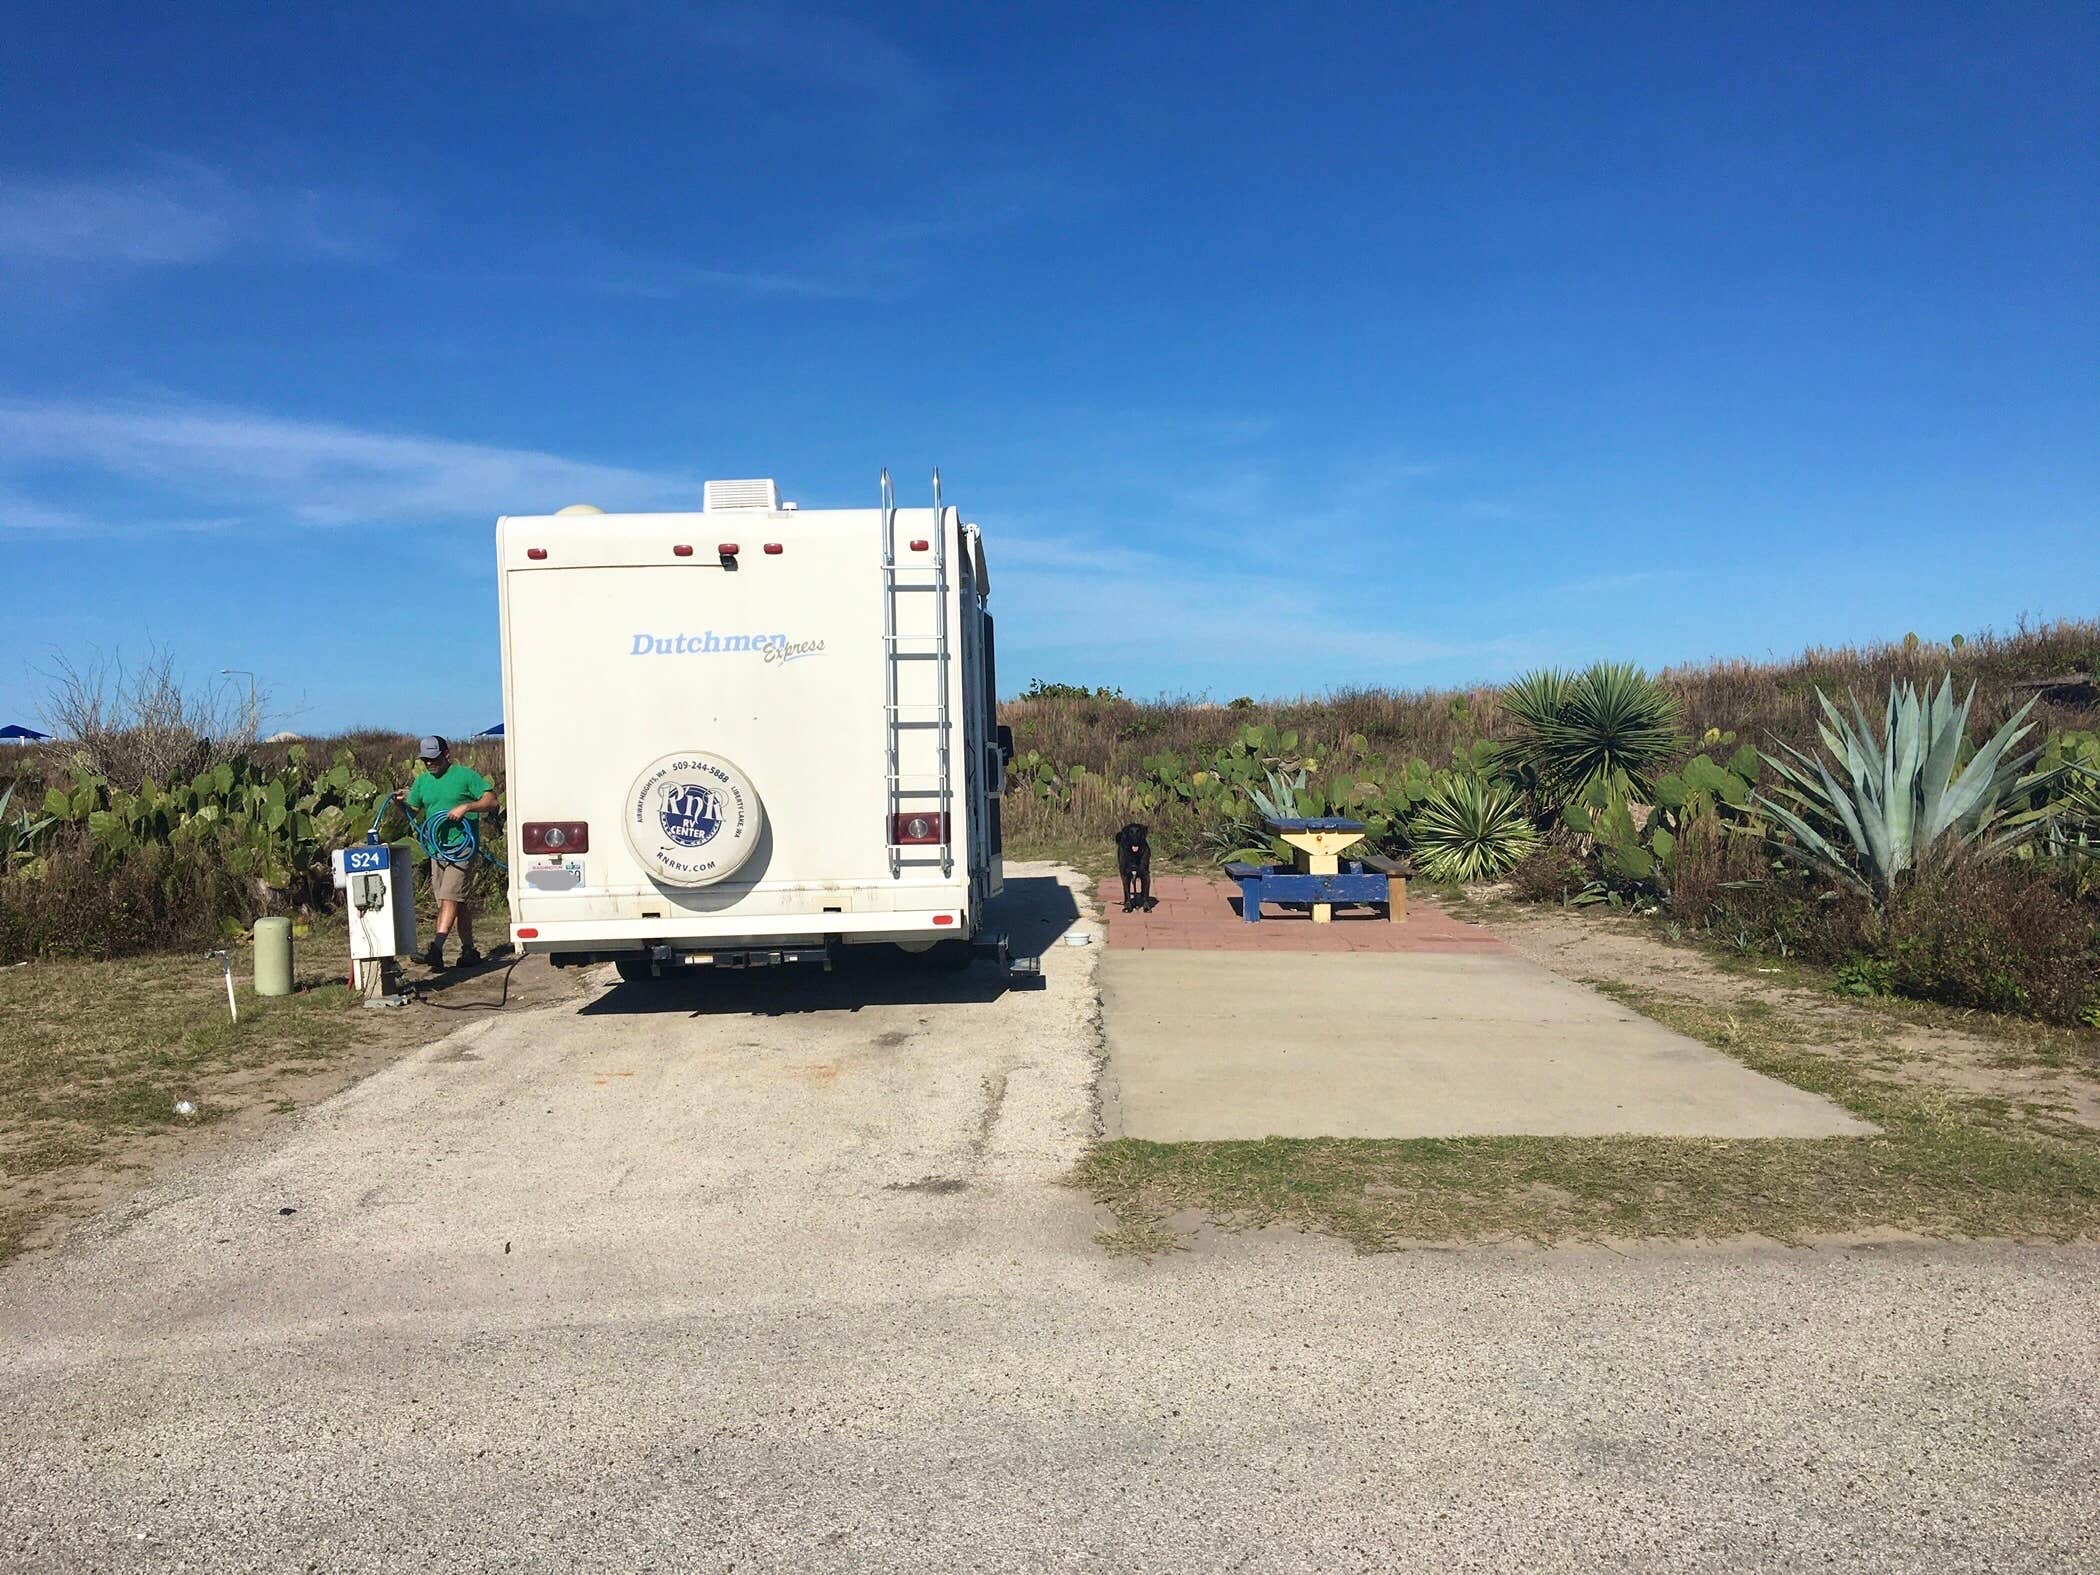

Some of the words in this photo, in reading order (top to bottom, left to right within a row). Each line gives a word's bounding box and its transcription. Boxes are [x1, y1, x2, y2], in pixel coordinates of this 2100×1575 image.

[630, 630, 787, 656] Dutchmen
[763, 639, 827, 664] Express
[672, 760, 730, 784] 509-244-5888
[636, 800, 644, 823] AIRWAY
[656, 769, 667, 778] WA
[731, 786, 744, 810] LIBERTY
[670, 825, 706, 839] CENTER
[683, 818, 696, 828] RV
[734, 828, 742, 838] WA
[350, 852, 380, 869] S24
[656, 851, 717, 873] RNRRV.COM
